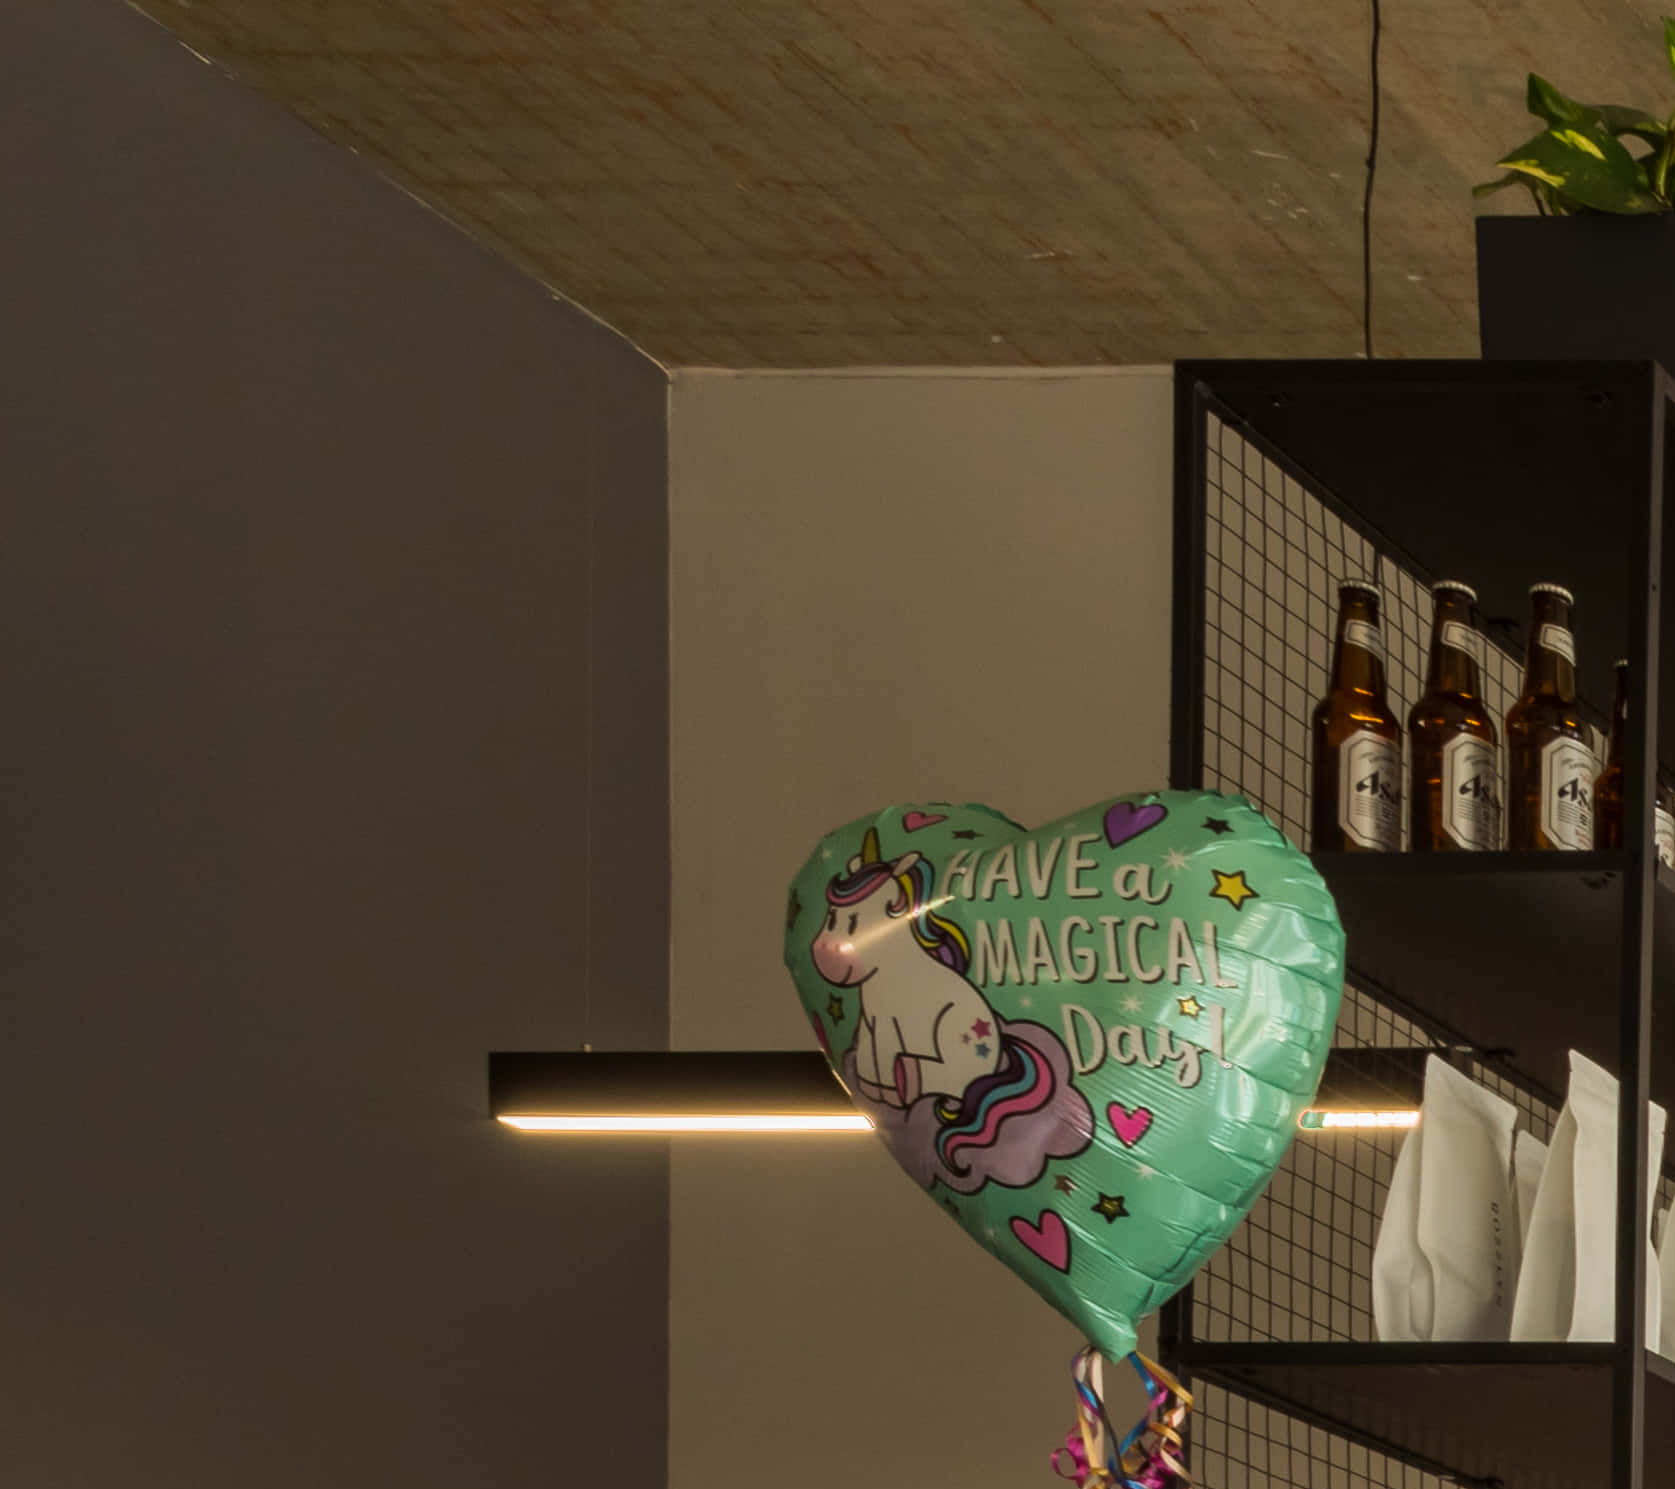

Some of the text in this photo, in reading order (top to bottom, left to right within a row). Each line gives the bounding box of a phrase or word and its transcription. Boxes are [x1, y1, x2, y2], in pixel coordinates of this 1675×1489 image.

[940, 833, 1173, 906] HAVE a
[975, 914, 1238, 989] MAGICAL
[1061, 1003, 1233, 1089] Day!
